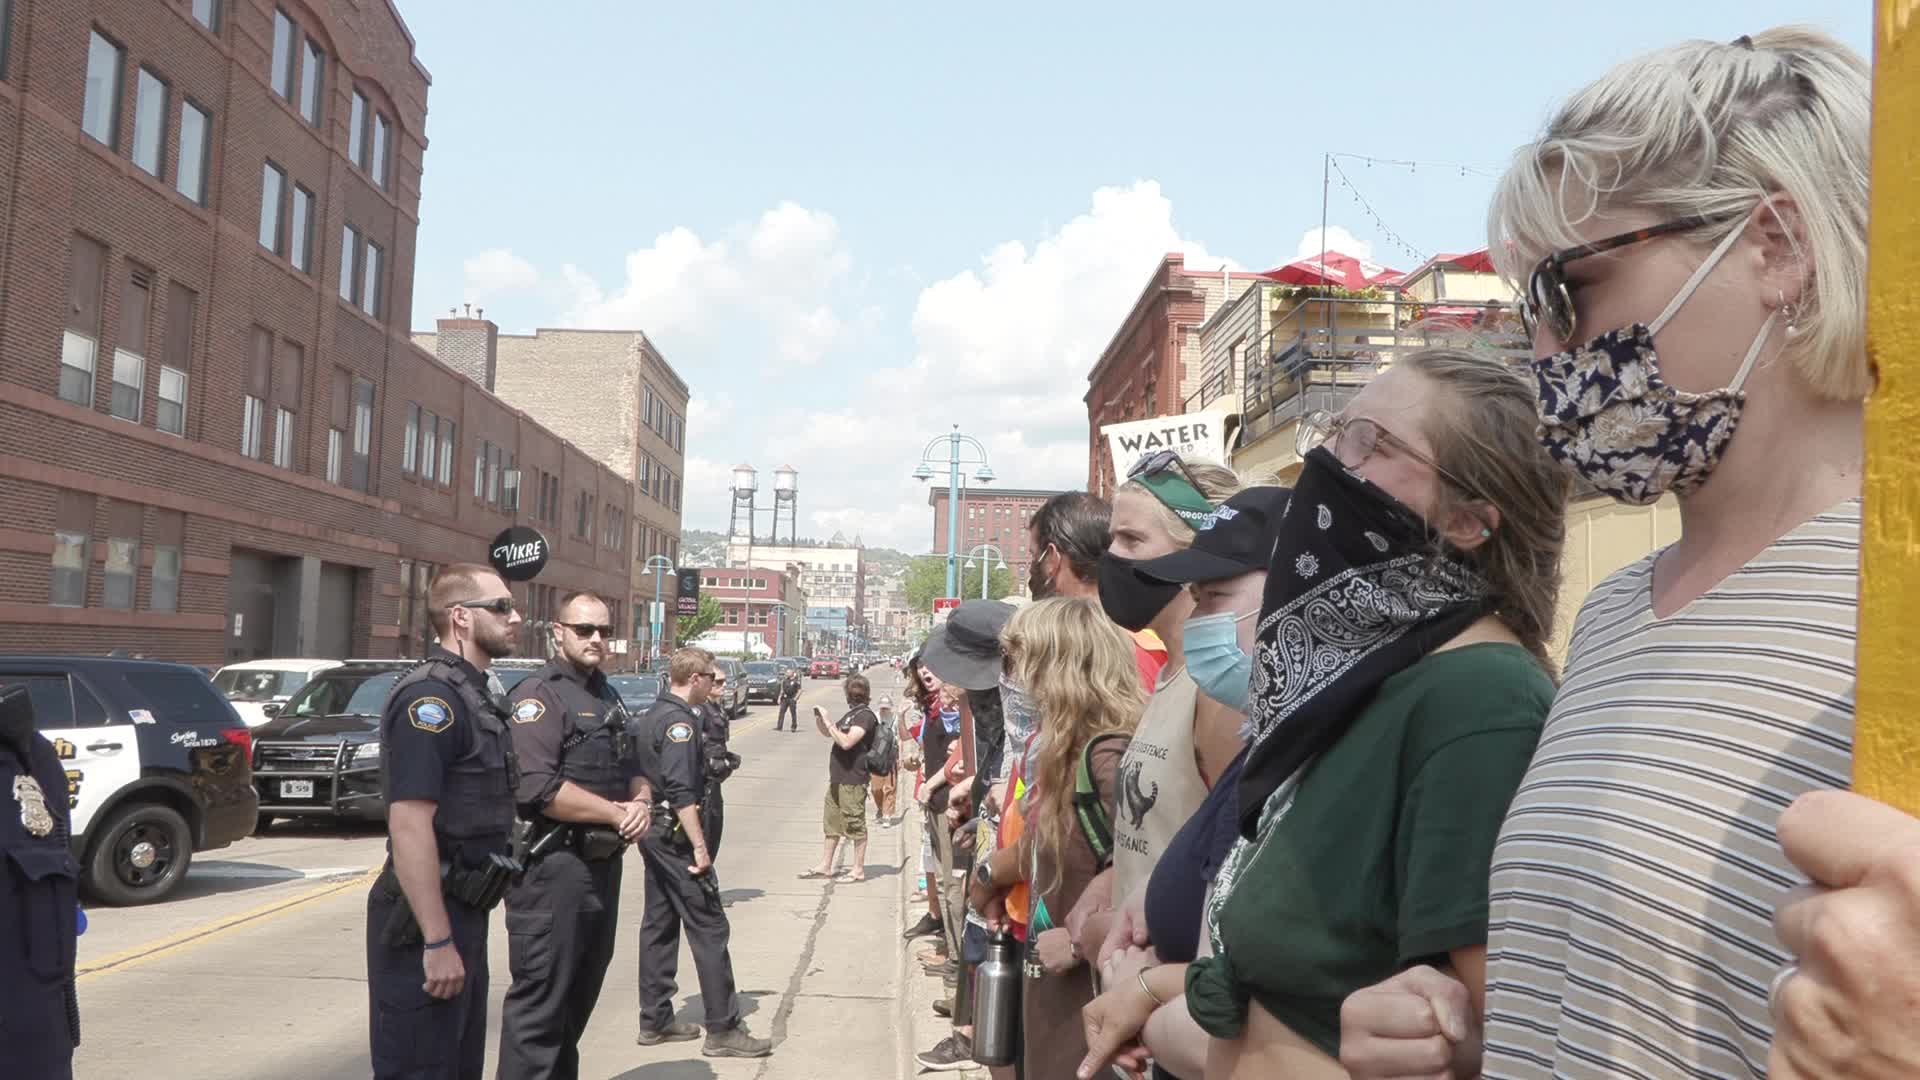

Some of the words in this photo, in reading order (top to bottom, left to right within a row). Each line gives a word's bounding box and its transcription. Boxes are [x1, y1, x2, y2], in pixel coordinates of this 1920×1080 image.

[1118, 423, 1208, 453] WATER
[493, 540, 542, 562] VIKRE
[200, 738, 218, 747] 1870
